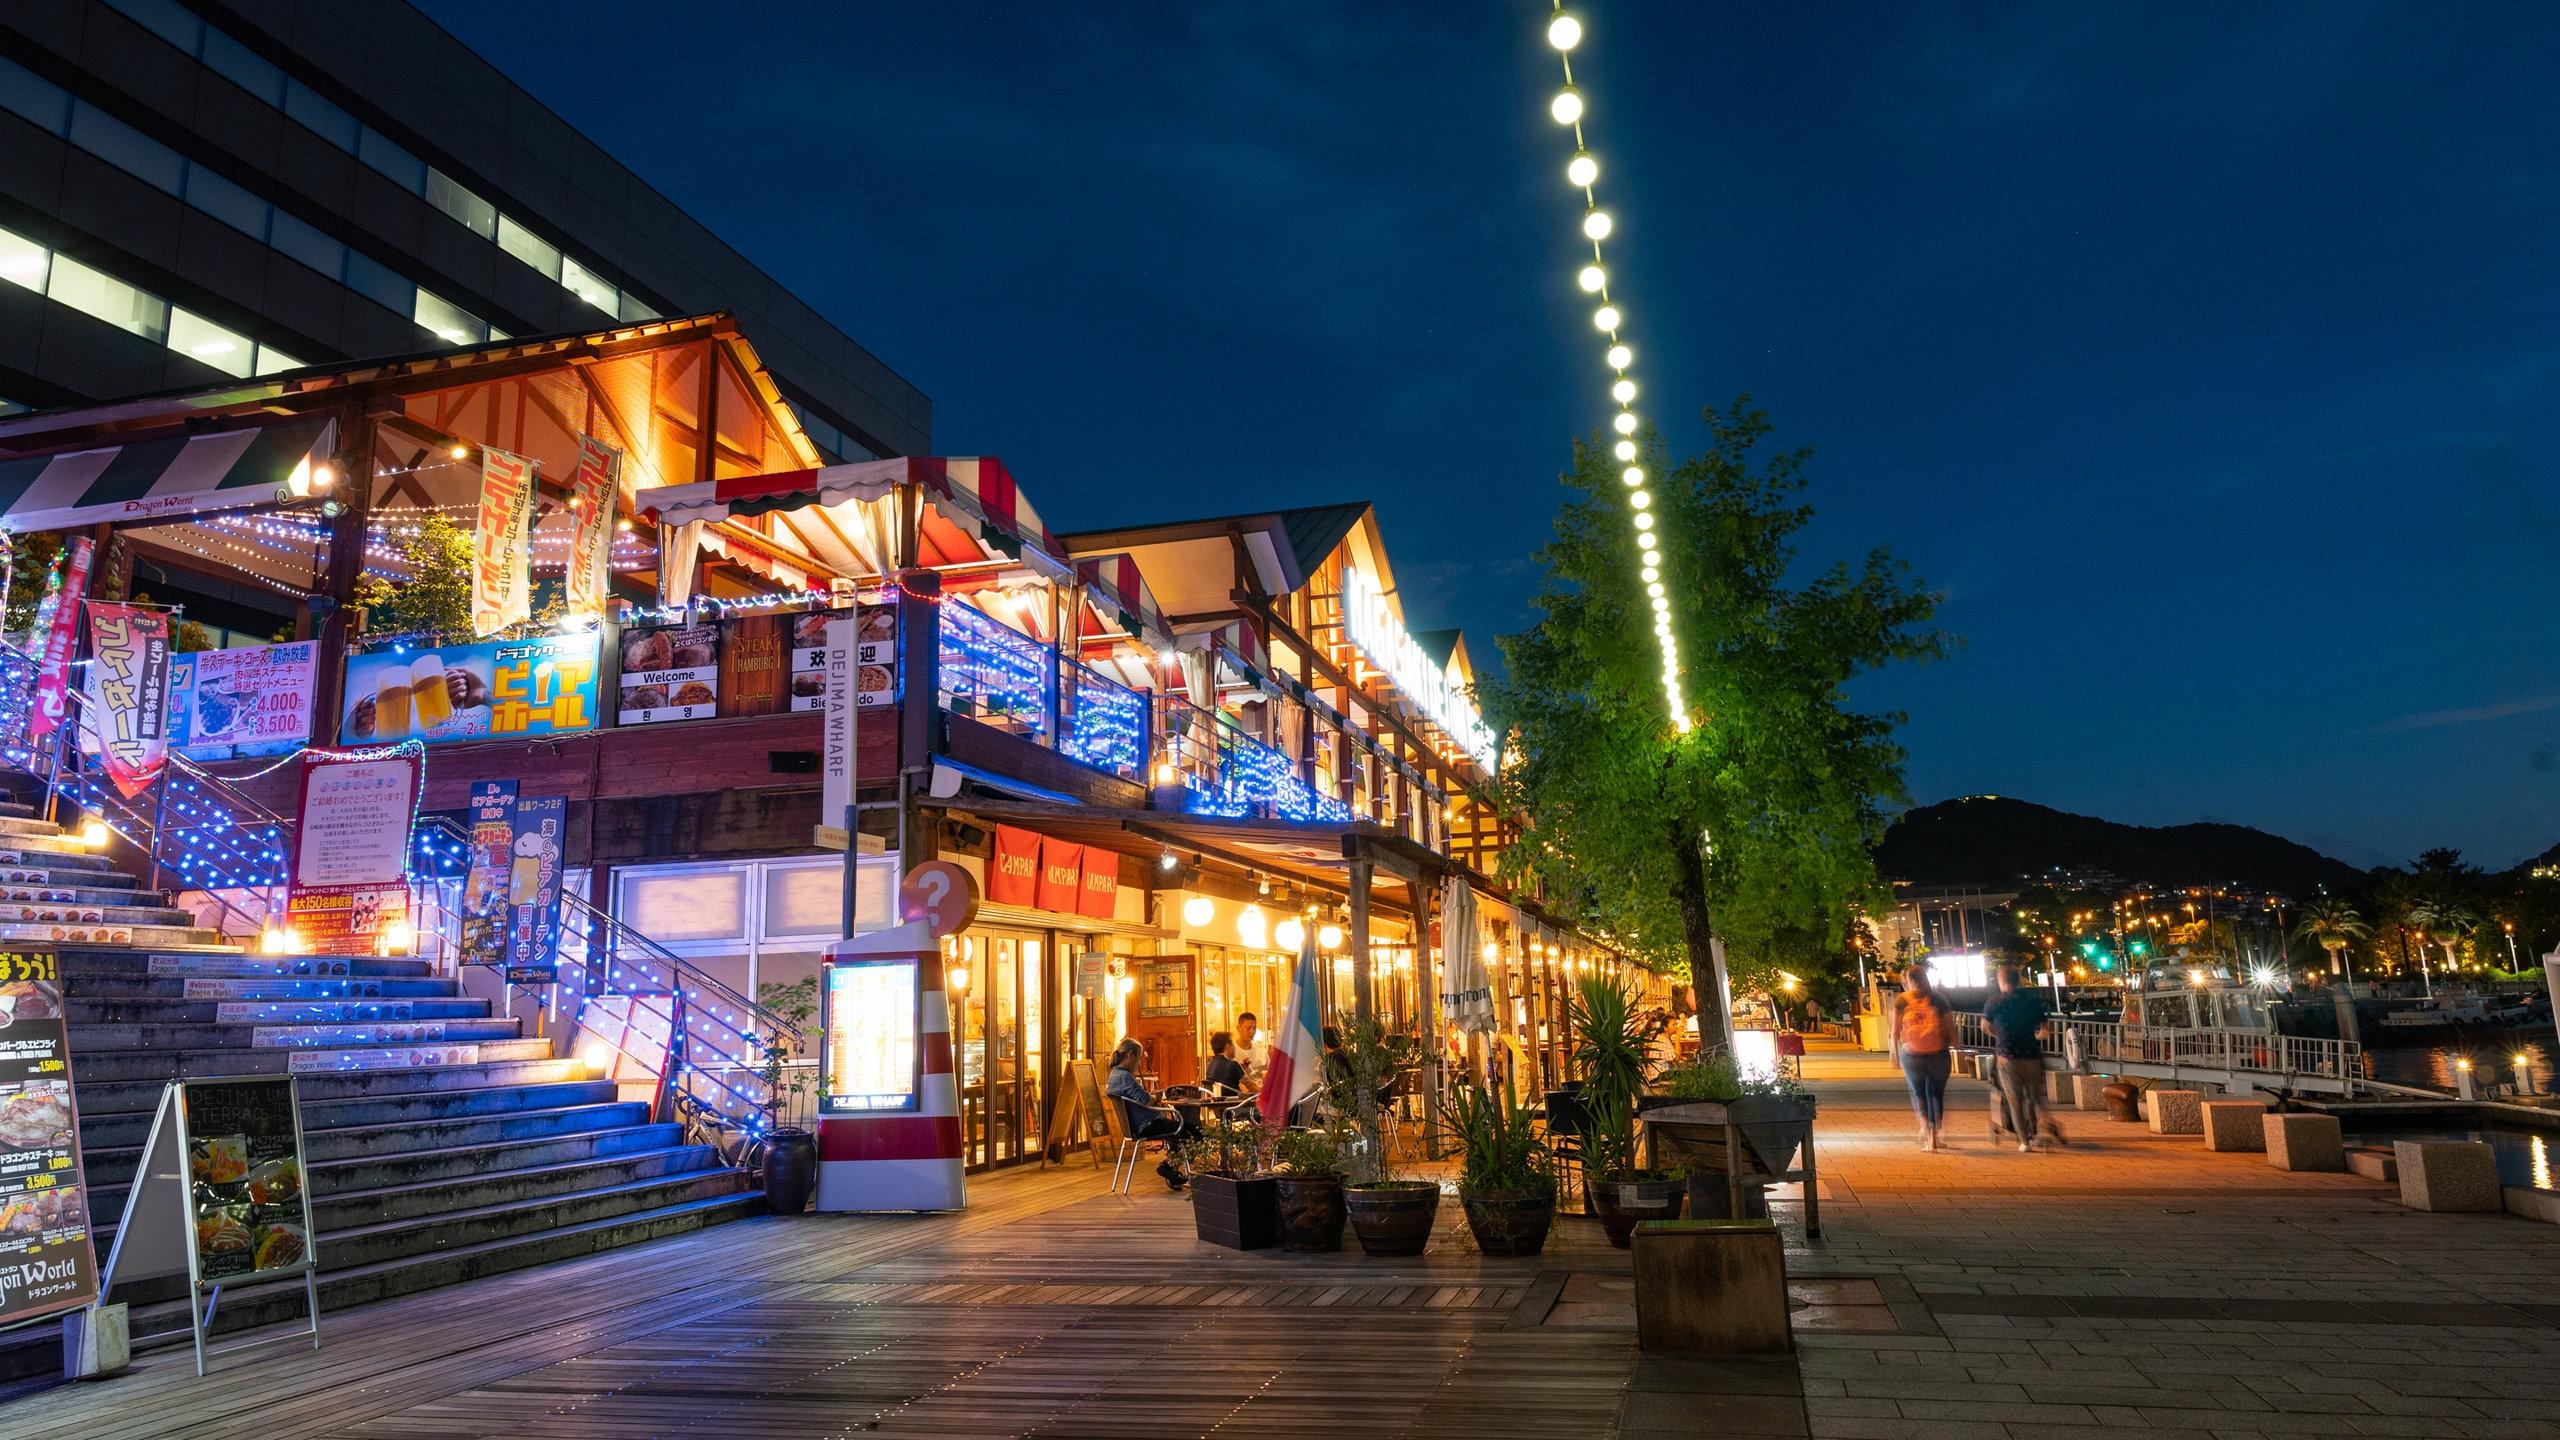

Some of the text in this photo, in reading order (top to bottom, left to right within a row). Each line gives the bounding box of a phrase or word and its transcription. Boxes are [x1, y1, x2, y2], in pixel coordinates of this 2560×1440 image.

[124, 496, 194, 516] Dragon World
[738, 635, 773, 653] STEAK
[860, 646, 876, 663] 迎
[737, 657, 773, 672] HAMBURG
[643, 670, 695, 684] Welcome
[490, 695, 590, 735] ホール
[684, 706, 692, 718] 영
[829, 649, 846, 777] DEJIMA WHARF
[472, 796, 514, 807] ビアガーデン
[518, 800, 562, 812] 出島ワーフ2F
[534, 819, 558, 962] 海のビアガーデン
[290, 895, 353, 910] 最大150名様収容
[516, 904, 532, 962] 開催中
[151, 965, 177, 974] Dragon
[178, 965, 198, 973] World
[188, 989, 212, 998] Dragon
[213, 989, 231, 997] World
[220, 1013, 245, 1022] Dragon
[256, 1029, 278, 1038] Dragon
[292, 1061, 334, 1070] Dragon World
[190, 1088, 260, 1107] DEJIMA
[199, 1106, 269, 1124] TERRACE
[26, 1174, 57, 1190] 3,500円
[20, 1258, 76, 1286] World
[28, 1280, 77, 1299] ドラゴンワールド
